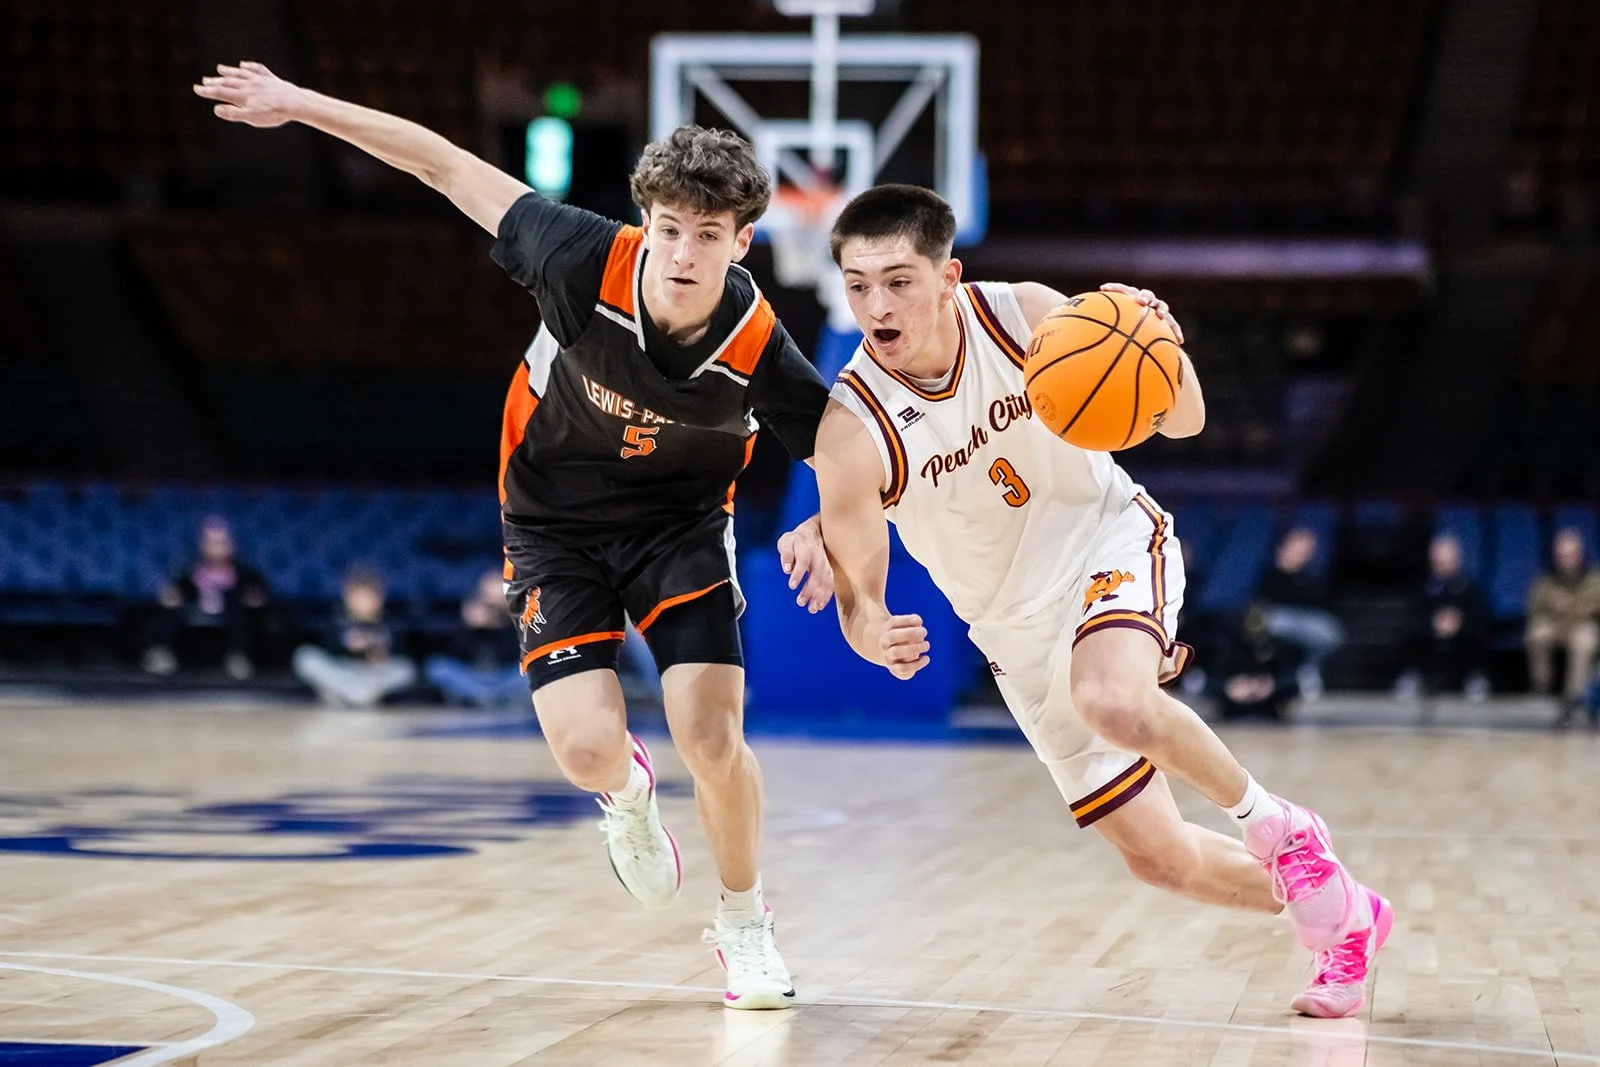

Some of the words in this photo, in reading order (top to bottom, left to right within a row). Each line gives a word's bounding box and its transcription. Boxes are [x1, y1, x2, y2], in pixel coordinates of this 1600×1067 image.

[620, 425, 660, 459] 5
[920, 424, 988, 488] Peach
[988, 389, 1032, 432] City
[988, 457, 1031, 508] 3
